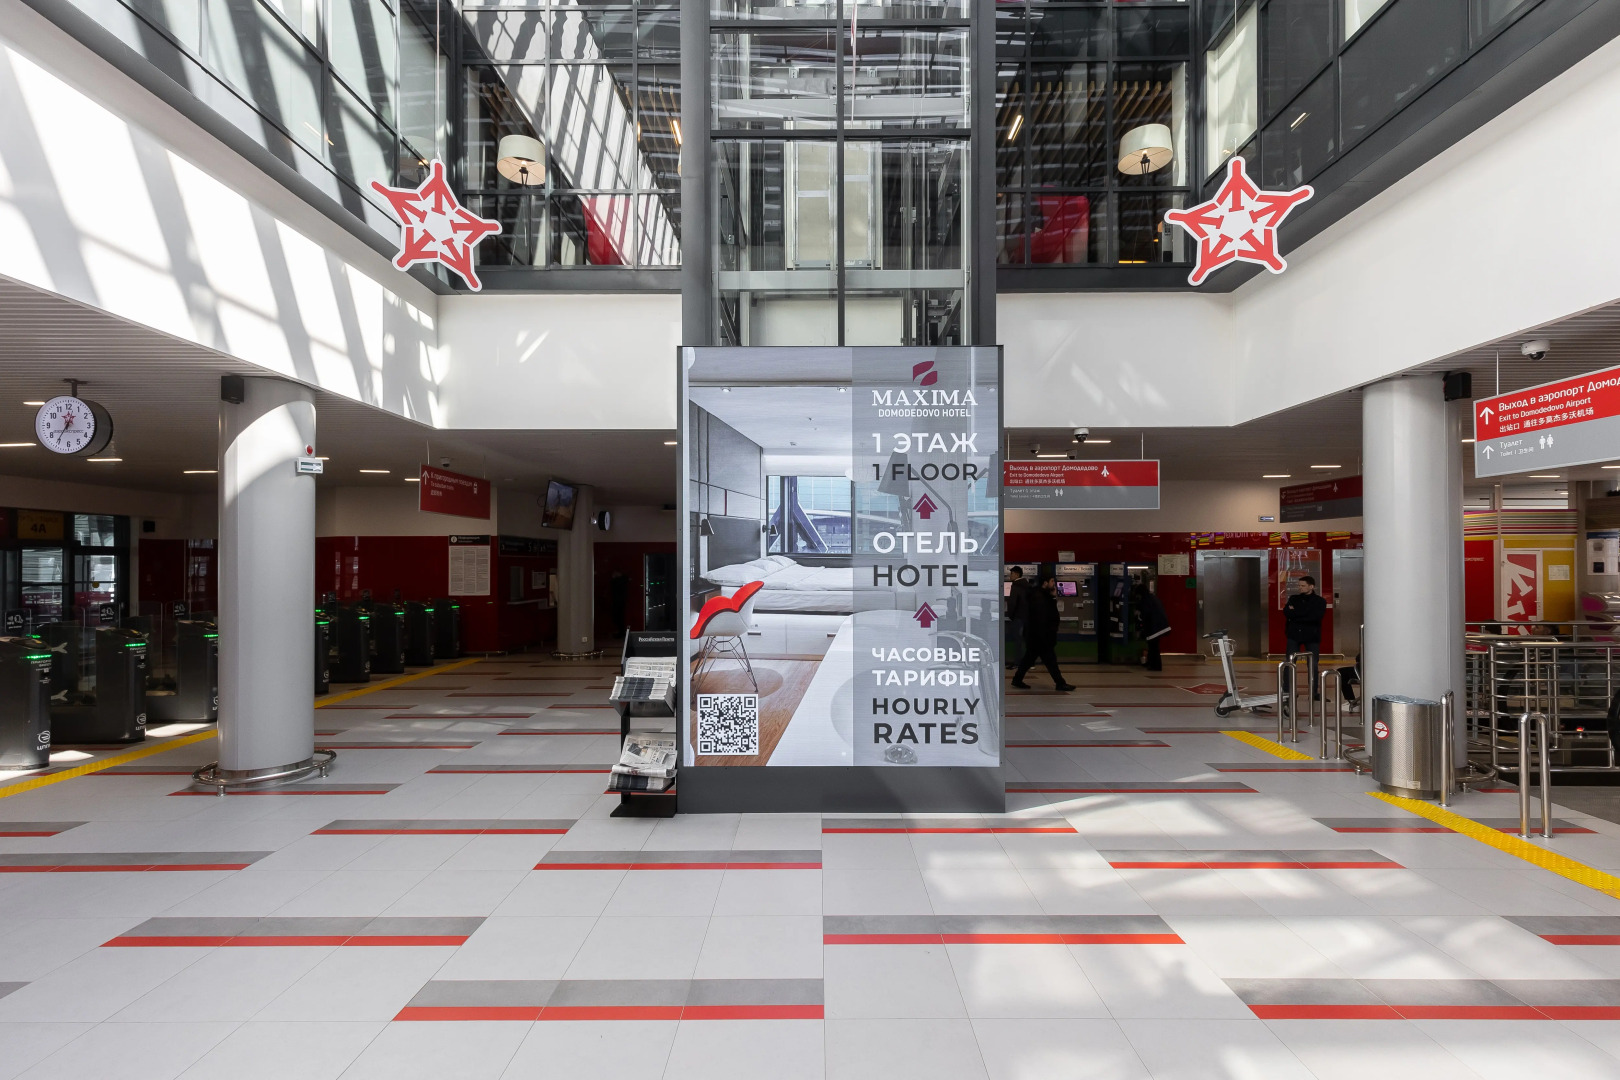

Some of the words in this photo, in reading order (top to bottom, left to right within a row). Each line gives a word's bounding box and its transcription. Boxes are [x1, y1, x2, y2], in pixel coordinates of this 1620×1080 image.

[872, 390, 978, 406] MAXIMA
[1498, 399, 1528, 412] Выход
[1530, 397, 1536, 405] в
[1538, 385, 1584, 402] аэропорт
[878, 408, 940, 417] DOMODEDOVO
[942, 408, 971, 417] HOTEL
[1520, 402, 1564, 418] Domodedovo
[1566, 397, 1592, 410] Airport
[1500, 422, 1520, 432] 出站口
[872, 433, 881, 453] 1
[893, 432, 978, 453] ЭТАЖ
[1500, 440, 1522, 449] Туалет
[872, 464, 880, 480] 1
[892, 463, 978, 481] FLOOR
[873, 532, 978, 554] ОТЕЛЬ
[874, 565, 978, 587] HOTEL
[872, 648, 980, 662] ЧАСОВЫЕ
[872, 670, 979, 686] ТАРИФЫ
[873, 698, 980, 715] HOURLY
[874, 722, 978, 744] RATES
